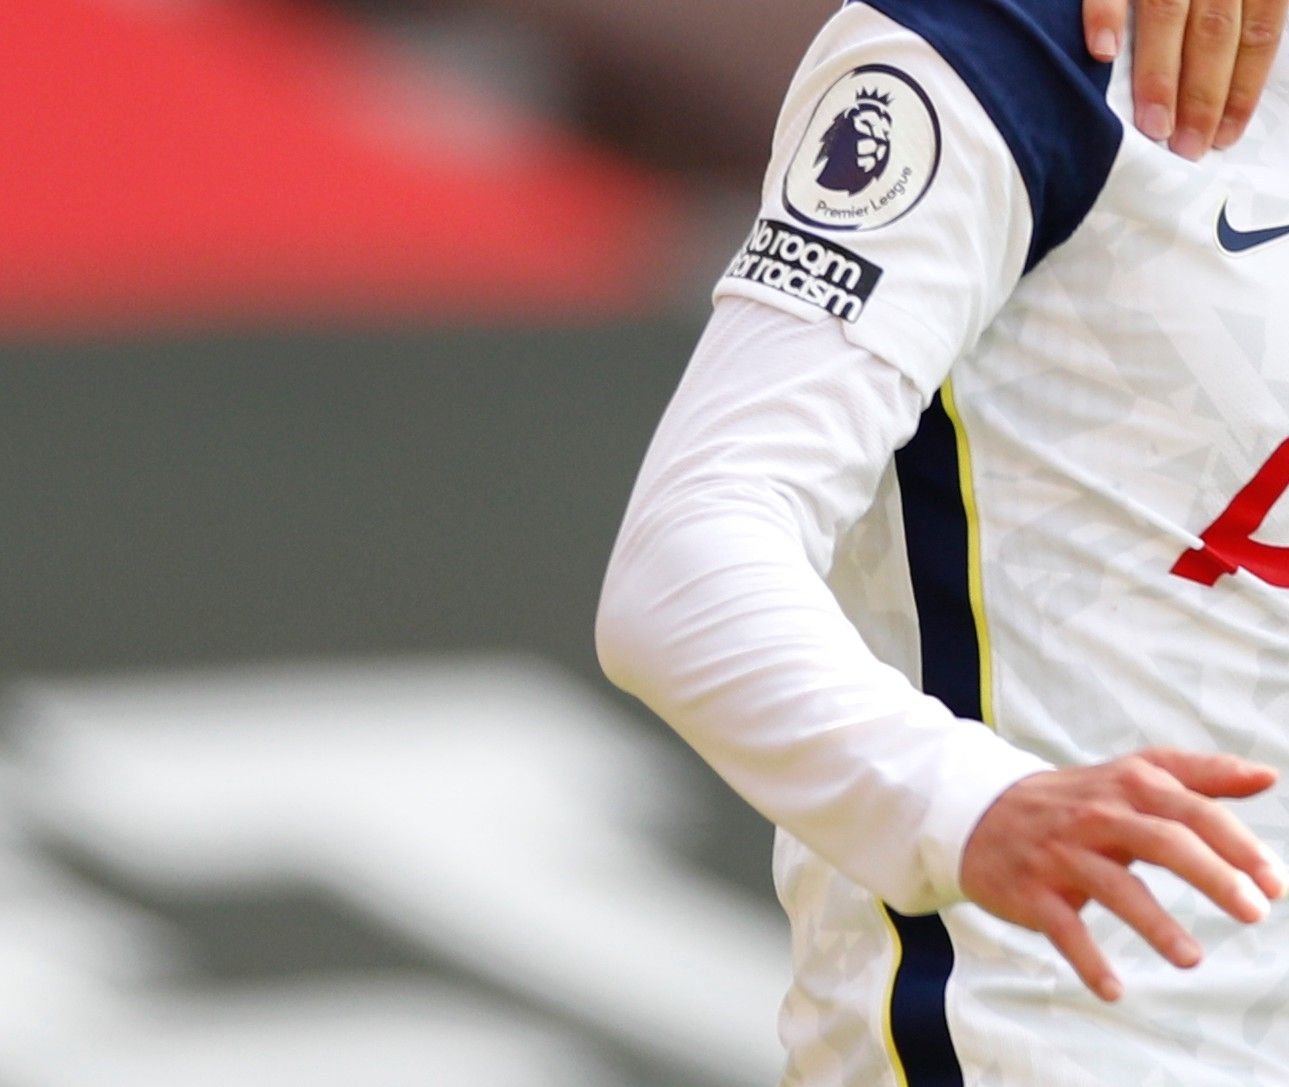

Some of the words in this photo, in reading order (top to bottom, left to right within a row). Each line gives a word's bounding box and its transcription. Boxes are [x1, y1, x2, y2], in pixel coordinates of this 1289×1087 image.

[816, 199, 868, 219] Premier
[869, 166, 912, 211] League
[744, 220, 773, 252] No
[769, 229, 862, 290] room
[752, 257, 863, 323] racism
